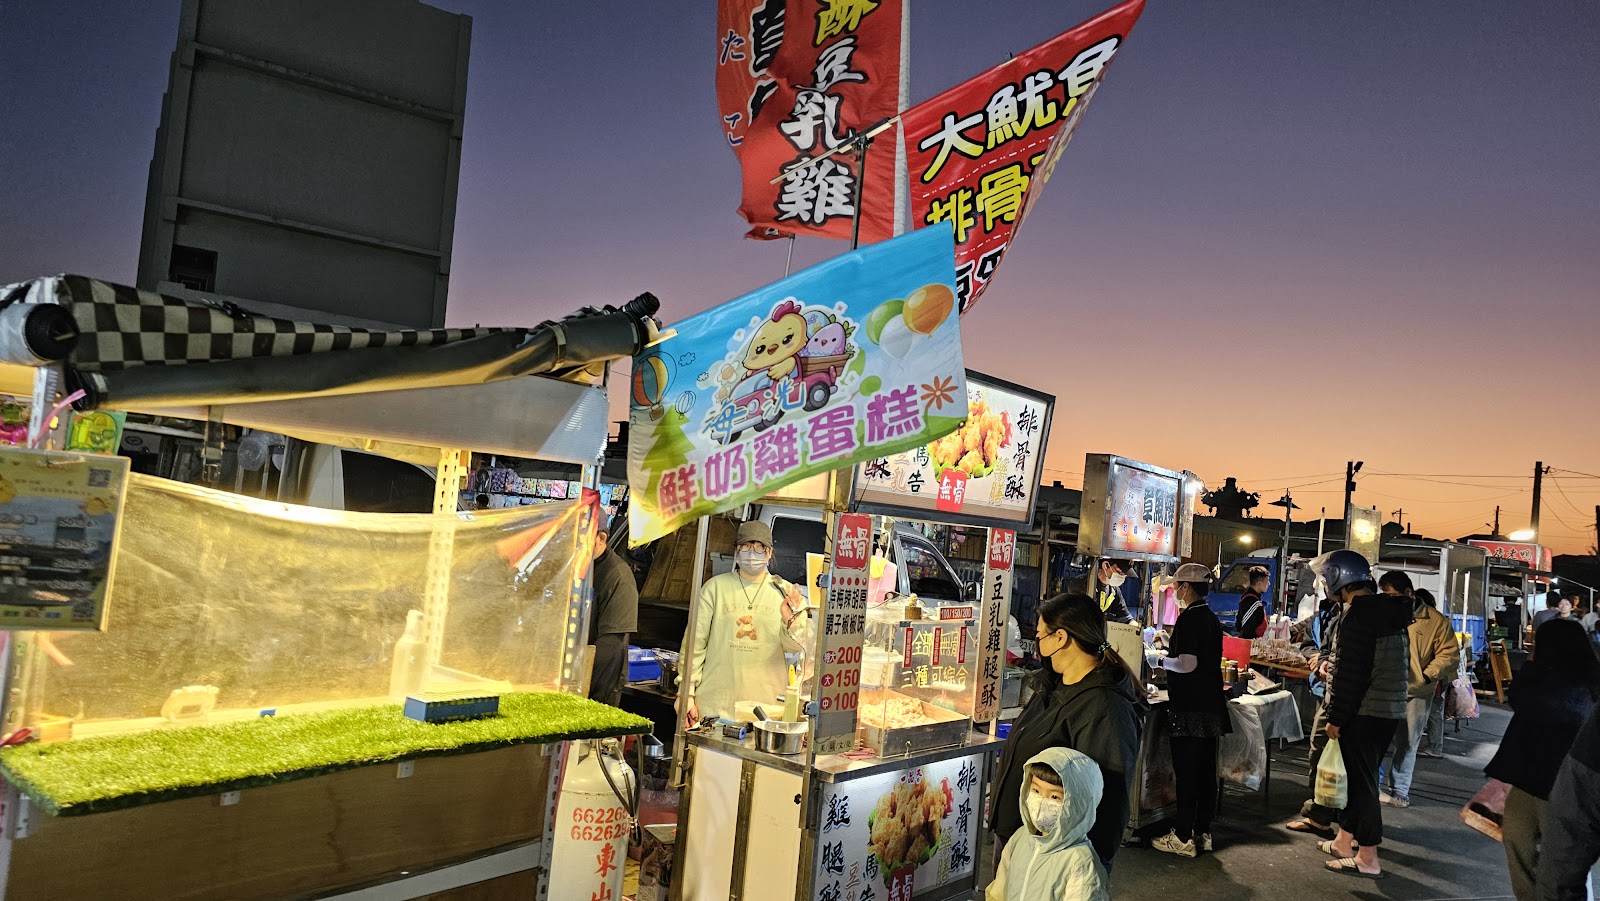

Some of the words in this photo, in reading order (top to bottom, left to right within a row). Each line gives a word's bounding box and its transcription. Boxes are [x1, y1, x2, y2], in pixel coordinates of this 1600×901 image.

[927, 153, 1047, 242] 排骨
[657, 384, 923, 516] 鮮奶雞蛋糕
[907, 446, 930, 493] 馬告
[1005, 404, 1038, 500] 排骨酥
[939, 477, 966, 504] 無骨
[837, 524, 869, 560] 無骨
[990, 529, 1013, 563] 無骨
[837, 645, 861, 664] 200
[981, 575, 1004, 707] 豆乳雞腿酥
[835, 668, 859, 687] 150
[901, 664, 968, 688] 三種可綜合
[833, 691, 857, 711] 100
[951, 759, 977, 873] 排骨酥
[819, 793, 851, 901] 雞腿酥
[592, 842, 618, 901] 東山
